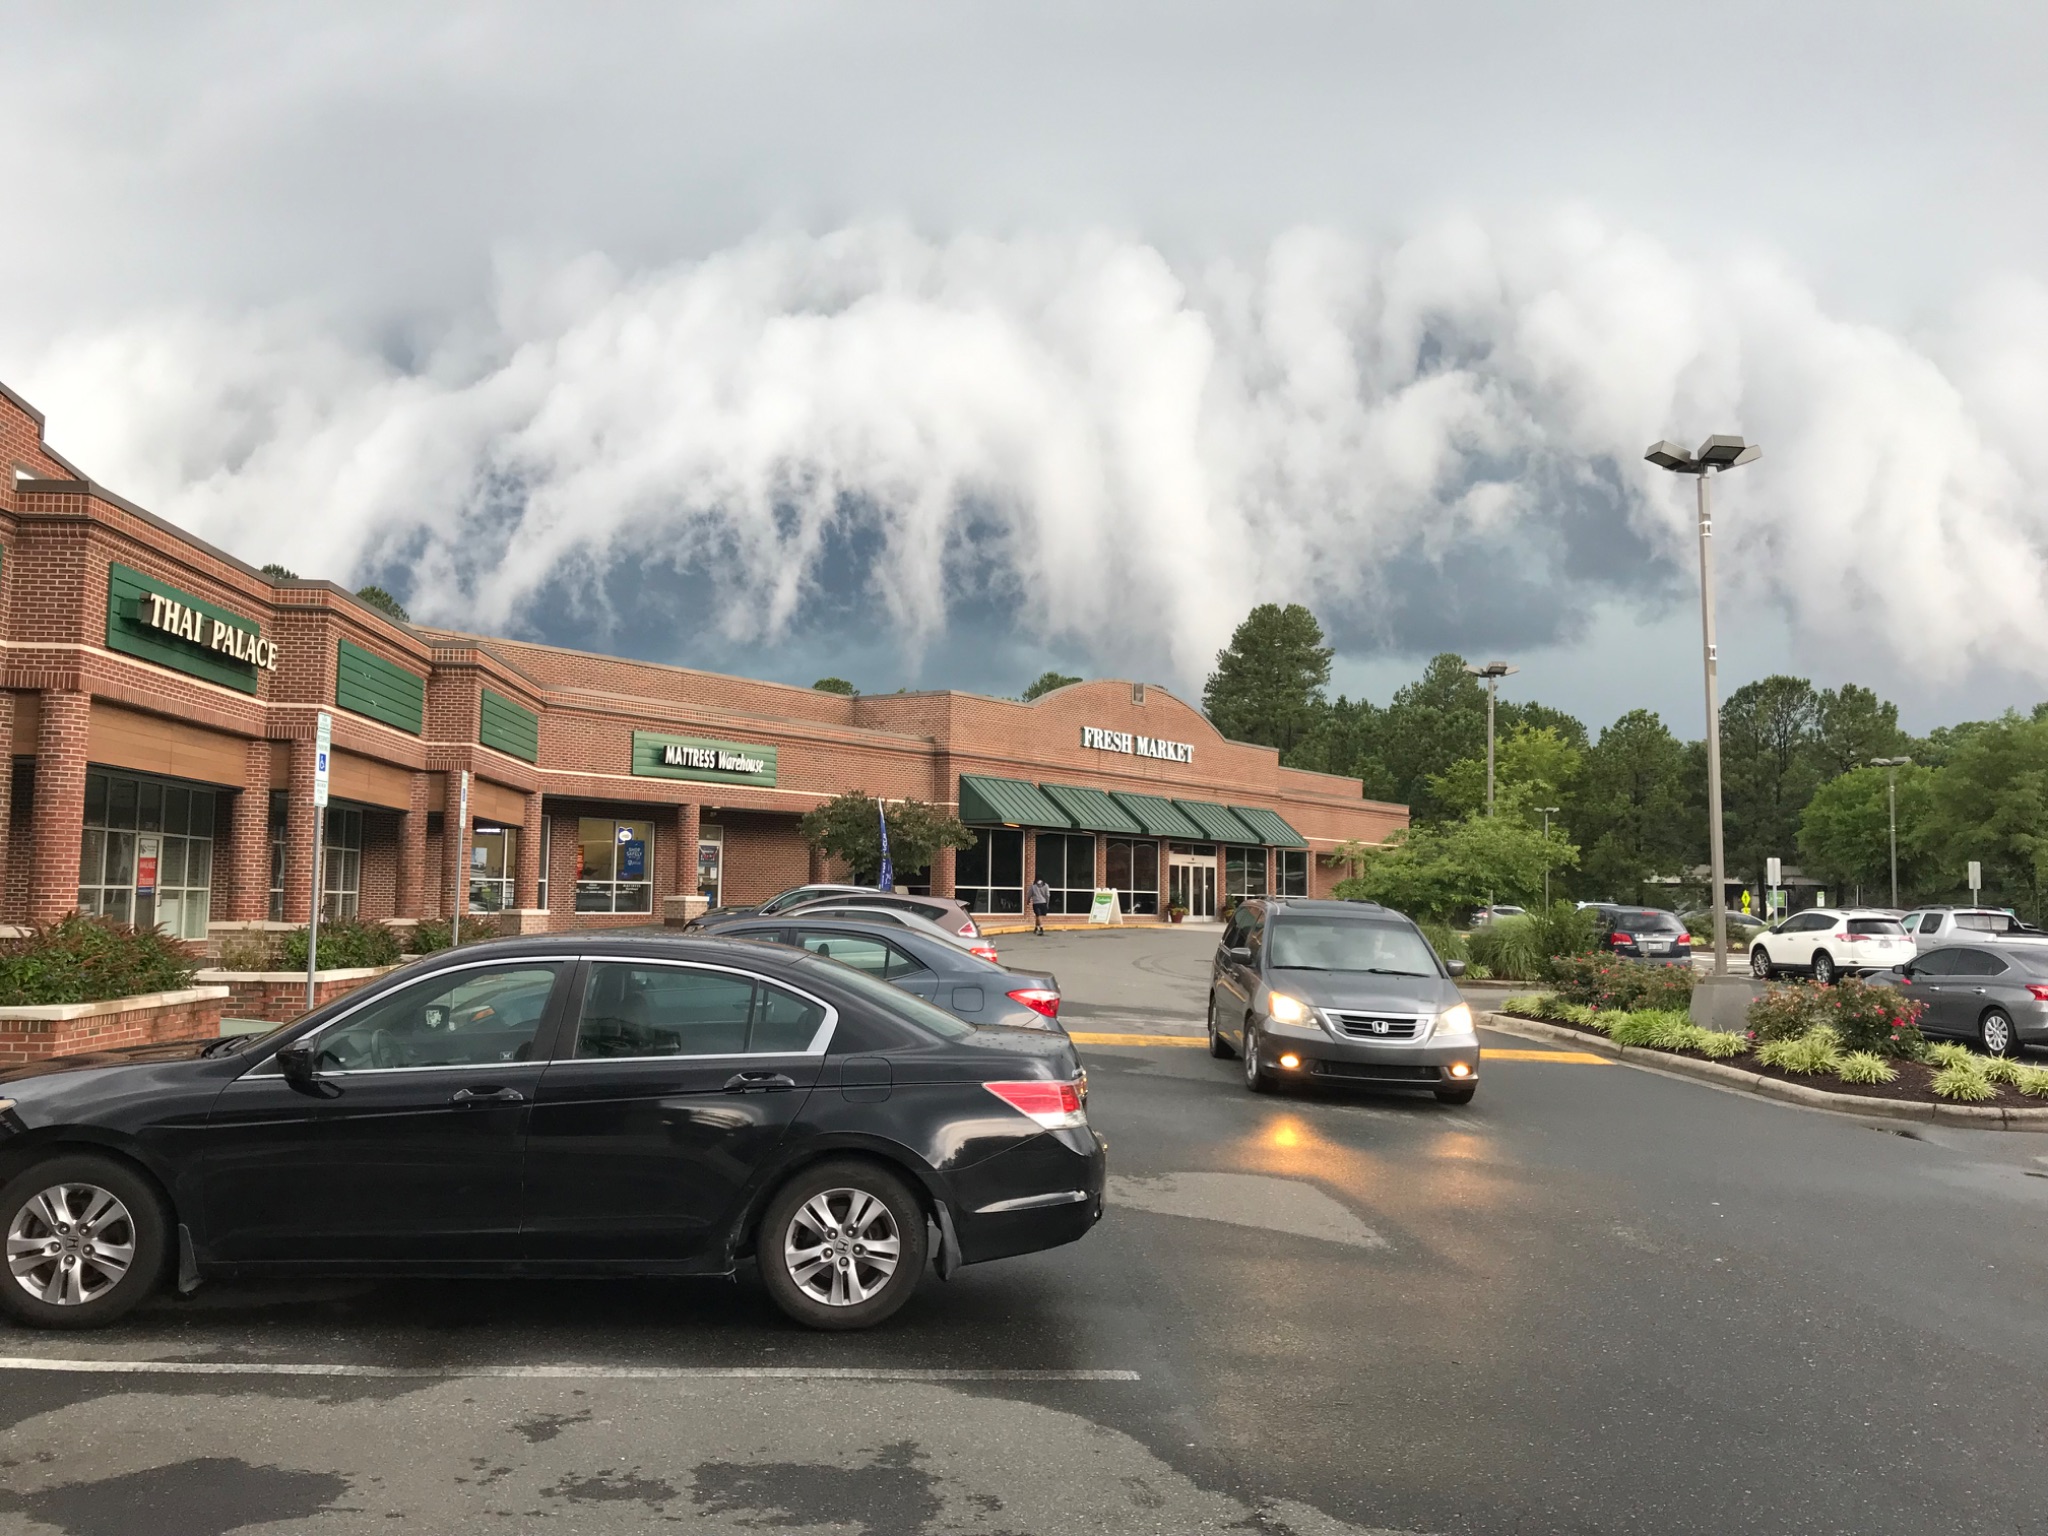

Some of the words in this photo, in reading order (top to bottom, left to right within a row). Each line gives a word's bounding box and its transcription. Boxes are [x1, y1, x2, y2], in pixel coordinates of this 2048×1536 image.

[151, 593, 202, 643] THAI
[211, 619, 278, 672] PALACE
[665, 745, 716, 769] MATTRESS
[718, 750, 764, 773] Warehouse
[1083, 726, 1133, 754] FRESH
[1136, 736, 1194, 764] MARKET
